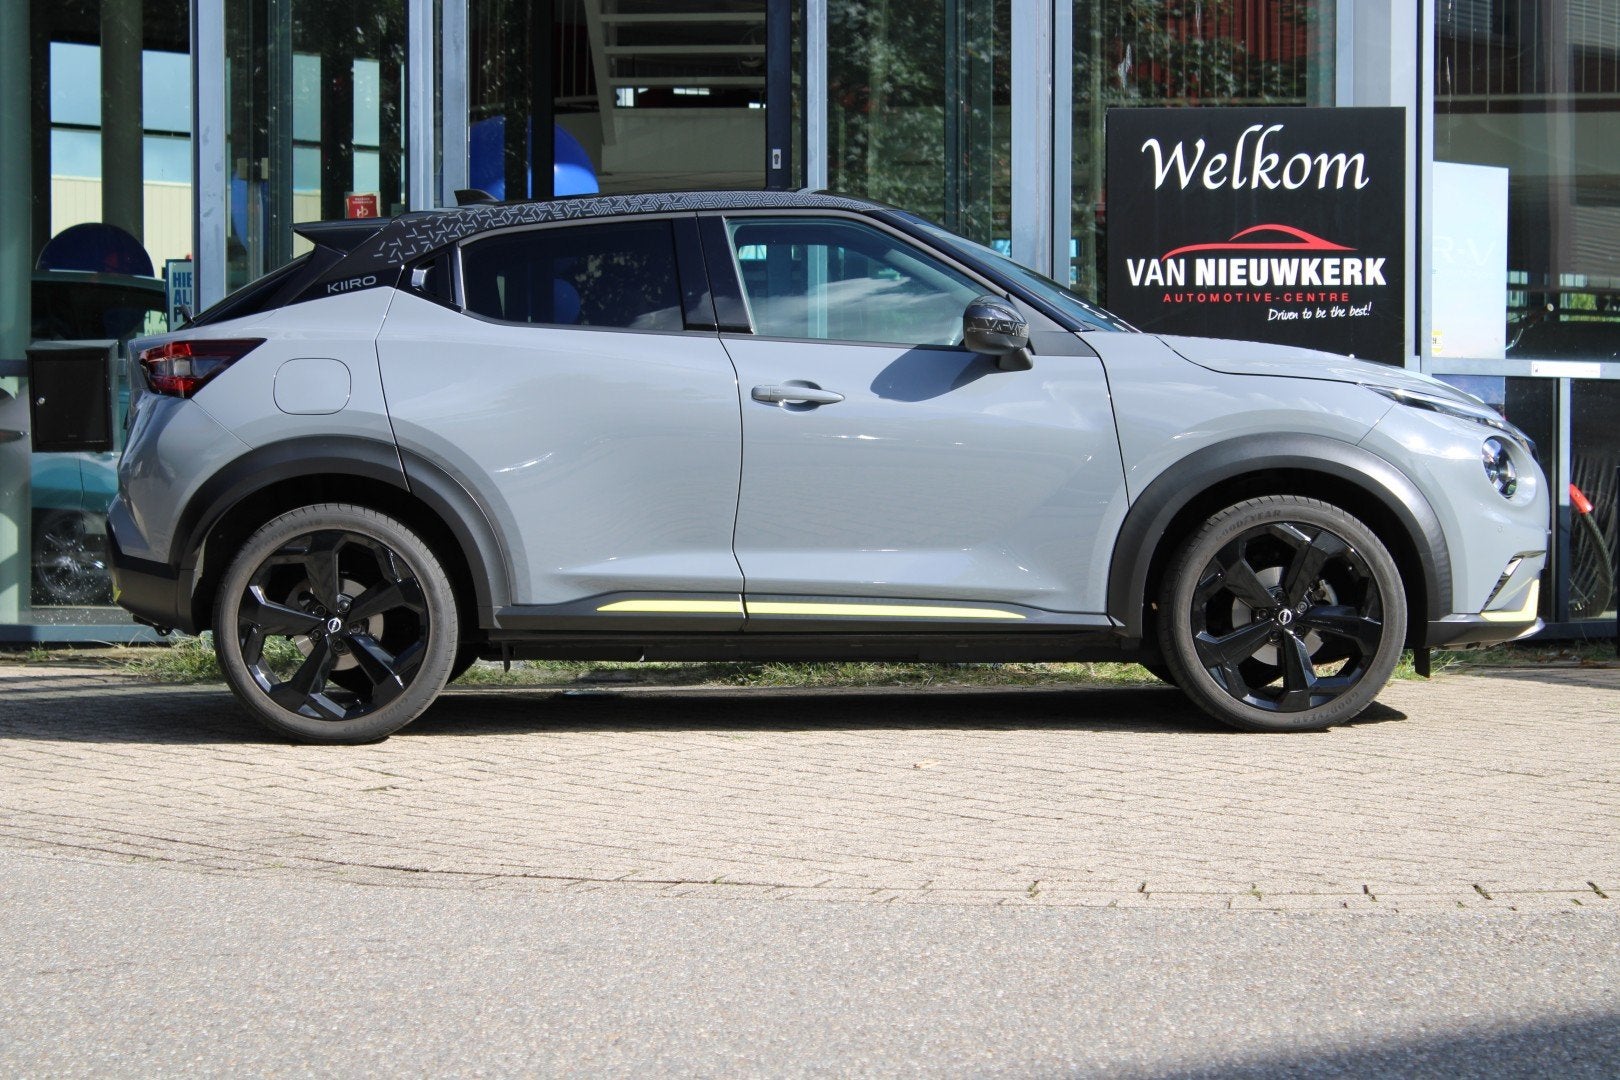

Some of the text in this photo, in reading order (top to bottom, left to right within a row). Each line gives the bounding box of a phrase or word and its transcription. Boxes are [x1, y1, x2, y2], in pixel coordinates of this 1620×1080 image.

[1141, 125, 1369, 190] Welkom
[1127, 257, 1386, 286] VAN NIEUWKERK
[327, 275, 377, 294] KIIRO
[1163, 292, 1349, 304] AUTOMOTIVE-CENTRE
[1267, 301, 1373, 322] Driven to be the best!
